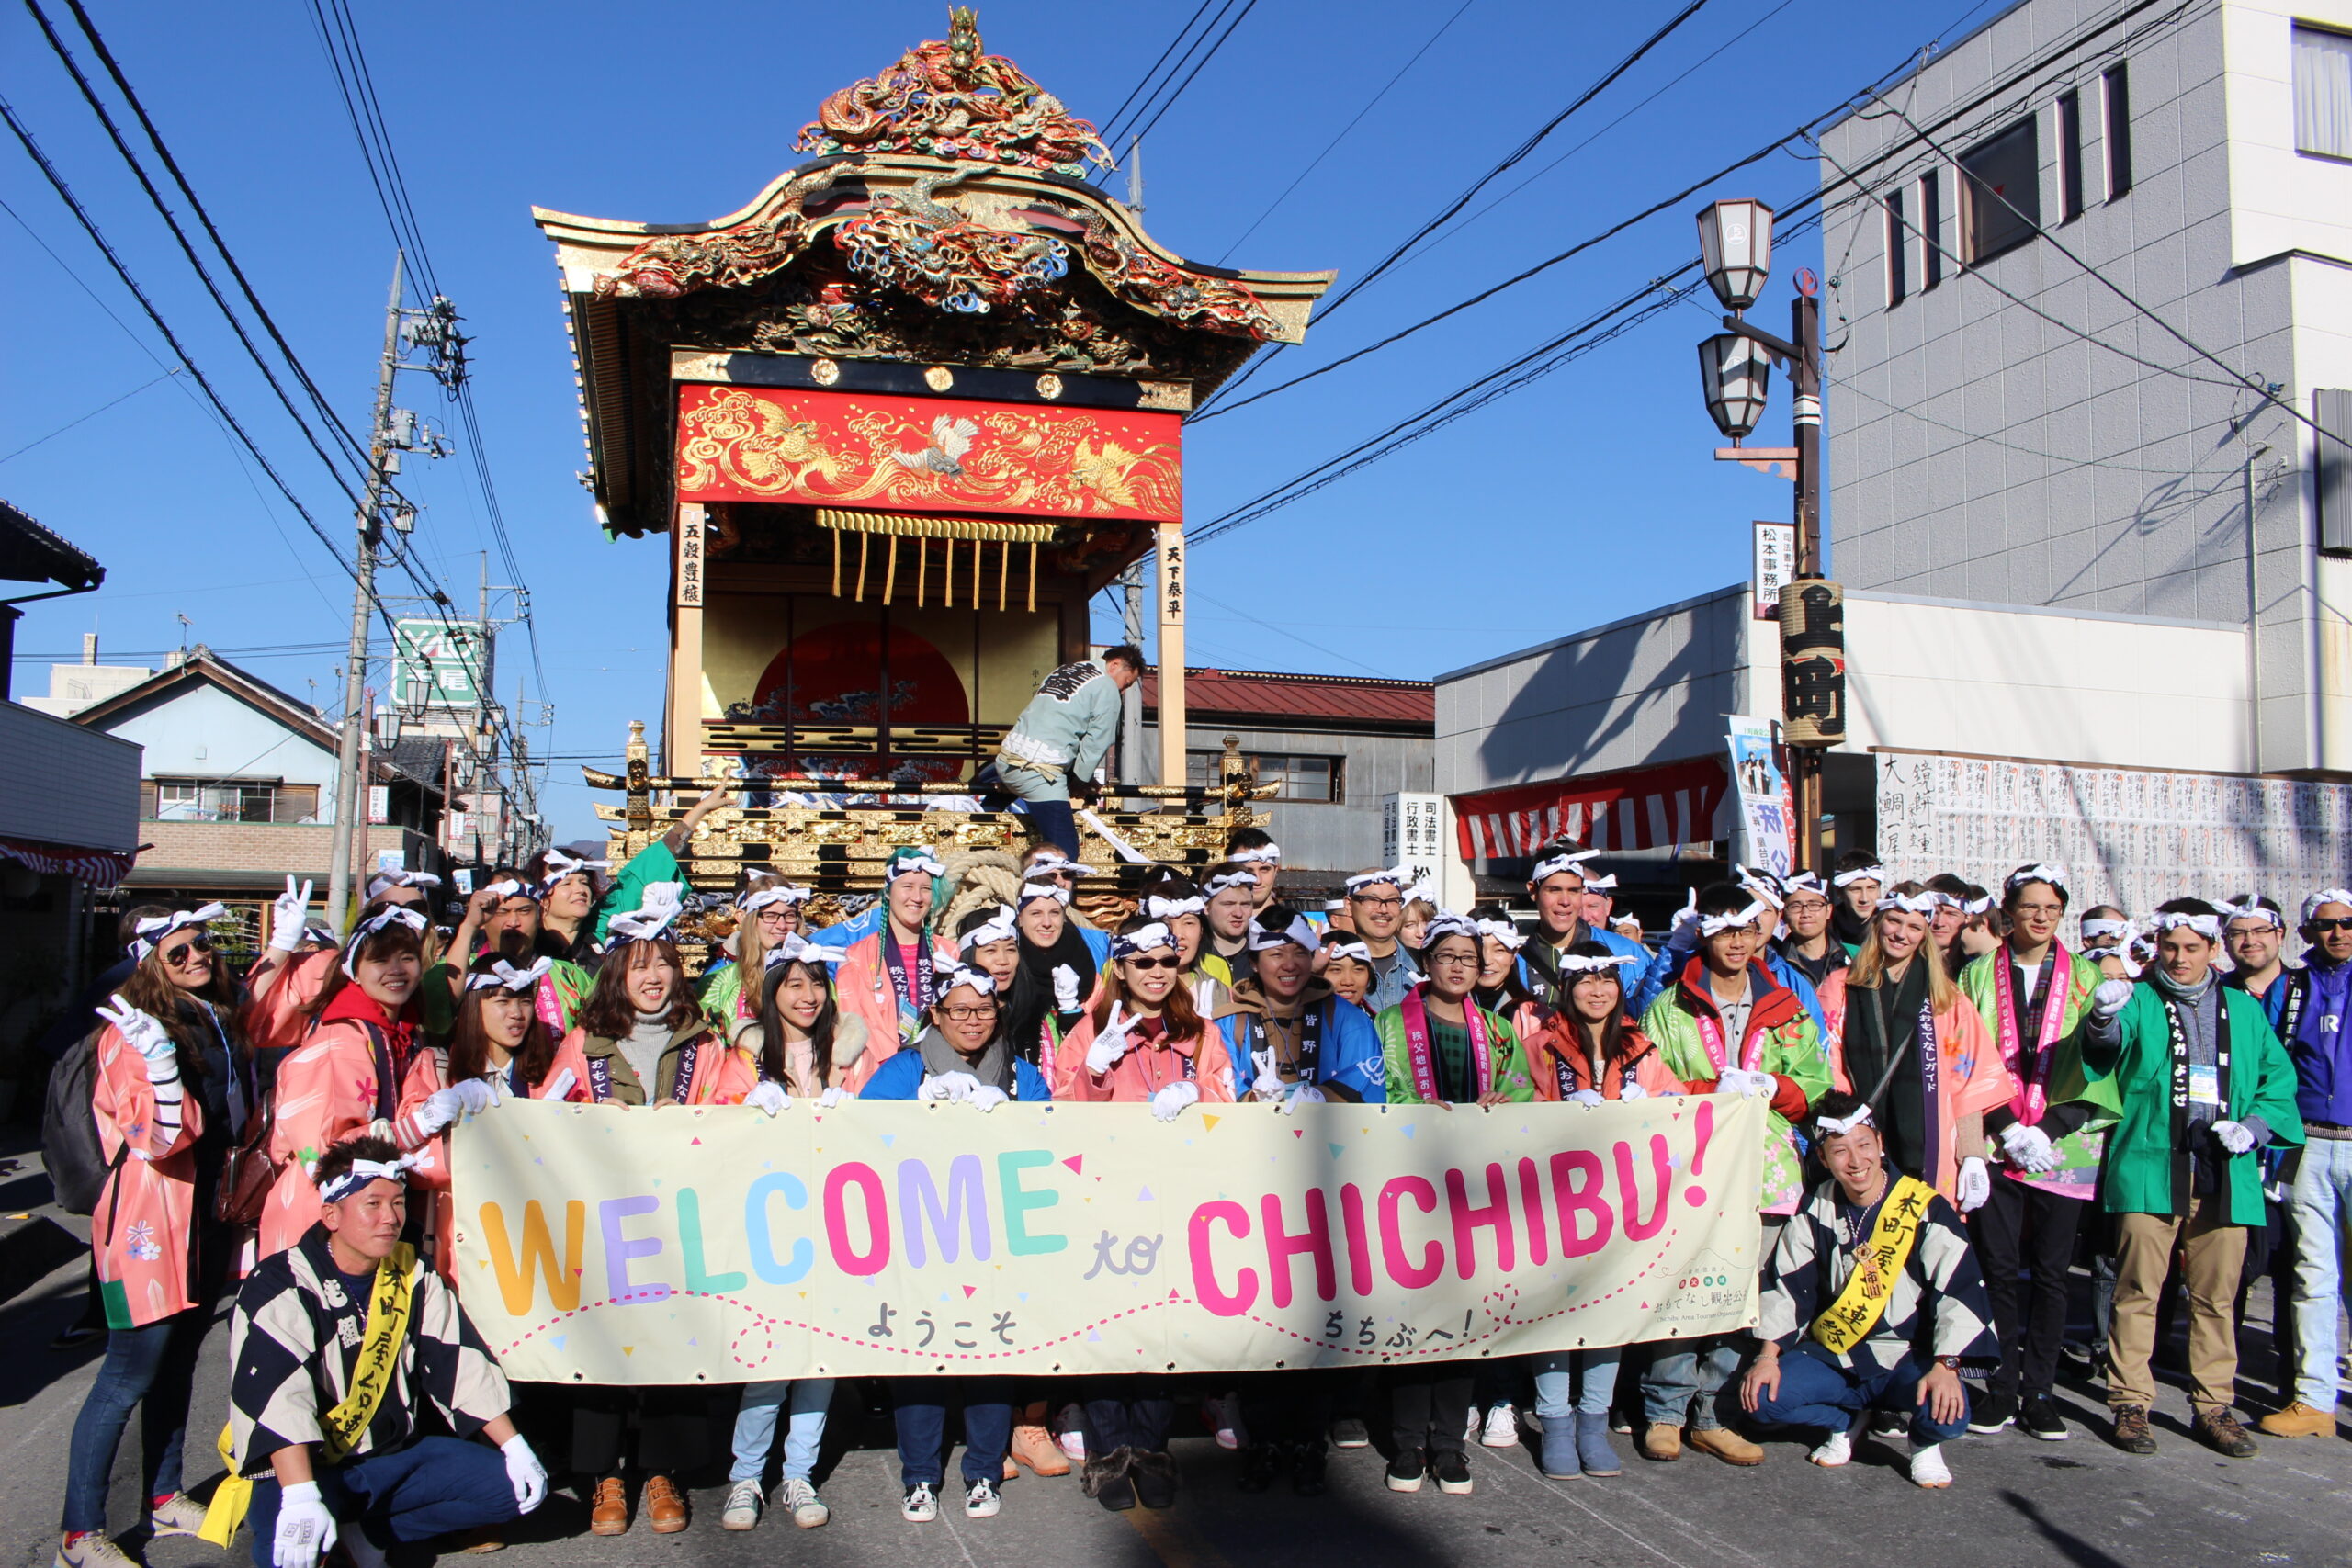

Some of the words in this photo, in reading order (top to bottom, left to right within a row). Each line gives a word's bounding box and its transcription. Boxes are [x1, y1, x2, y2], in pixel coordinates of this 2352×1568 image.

[1762, 528, 1778, 601] 松本事務所
[1783, 533, 1792, 572] 司法書士
[1167, 547, 1182, 619] 天下泰平
[1783, 584, 1845, 735] 上町
[1407, 802, 1418, 856] 行政書士
[1424, 802, 1436, 856] 司法書士
[1300, 1014, 1318, 1081] 皆野町
[479, 1149, 1069, 1316] WELCOME
[1083, 1229, 1163, 1280] to
[1187, 1100, 1714, 1317] CHICHIBU!
[1867, 1271, 1882, 1298] 市川
[867, 1302, 1018, 1348] ようこそ
[1681, 1313, 1695, 1321] Area
